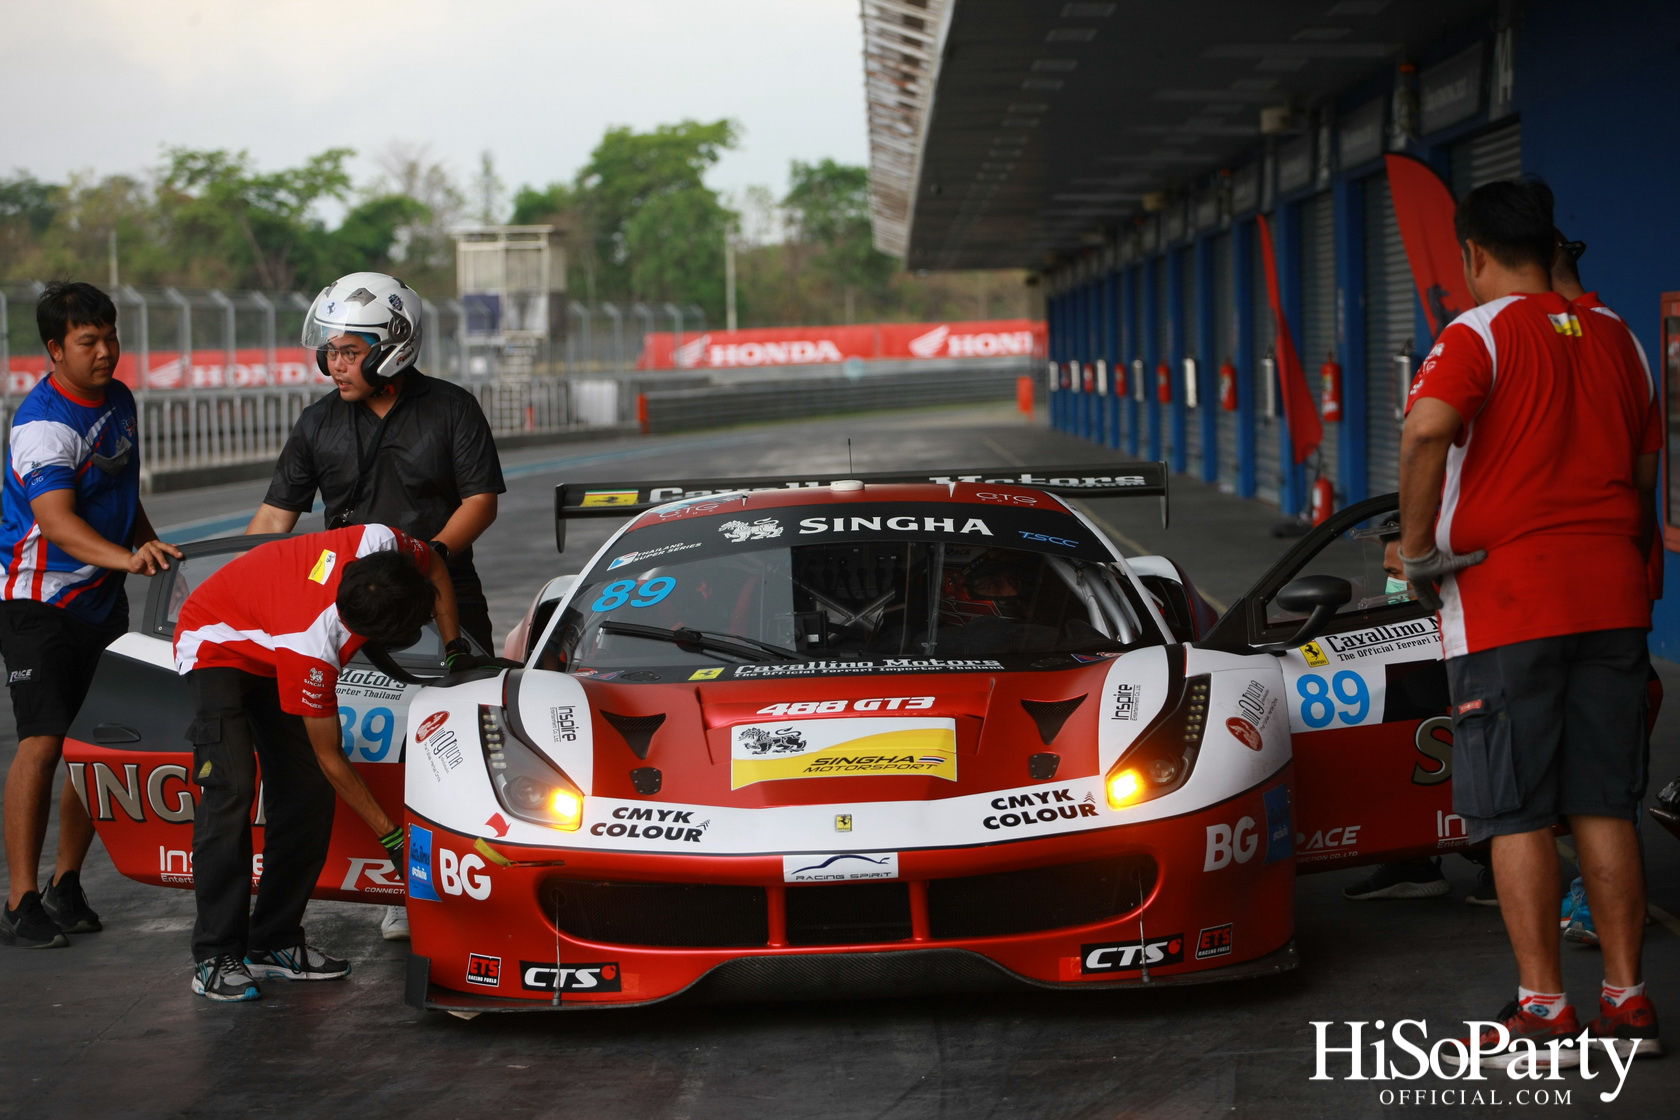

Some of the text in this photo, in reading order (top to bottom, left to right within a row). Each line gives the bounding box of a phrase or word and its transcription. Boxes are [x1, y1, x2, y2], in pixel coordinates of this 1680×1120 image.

[710, 340, 843, 367] HONDA
[799, 516, 994, 536] SINGHA
[637, 542, 684, 557] THAILAND
[1018, 530, 1080, 548] TSCC
[632, 542, 702, 562] SUPER SERIES
[591, 576, 677, 612] 89
[1325, 622, 1426, 653] Cavallino
[1337, 654, 1356, 662] The
[1358, 644, 1395, 658] Official
[1397, 637, 1431, 650] Ferrari
[735, 658, 1001, 674] Cavallino Motors
[339, 668, 408, 689] Motors
[363, 689, 402, 701] Thailand
[1111, 683, 1134, 721] Inspire
[1296, 669, 1371, 729] 89
[756, 696, 936, 716] 488 GT3
[558, 705, 580, 742] Inspire
[803, 763, 938, 773] MOTORSPORT
[810, 755, 916, 766] SINGHA
[991, 788, 1075, 810] CMYK
[611, 806, 696, 824] CMYK
[983, 803, 1099, 830] COLOUR
[590, 822, 703, 843] COLOUR
[1203, 816, 1259, 872] BG
[439, 847, 492, 901] BG
[1200, 928, 1231, 949] ETS
[1086, 941, 1169, 969] CTS
[1198, 949, 1217, 957] RACING
[468, 974, 483, 982] RACING
[469, 957, 499, 978] ETS
[524, 967, 601, 988] CTS
